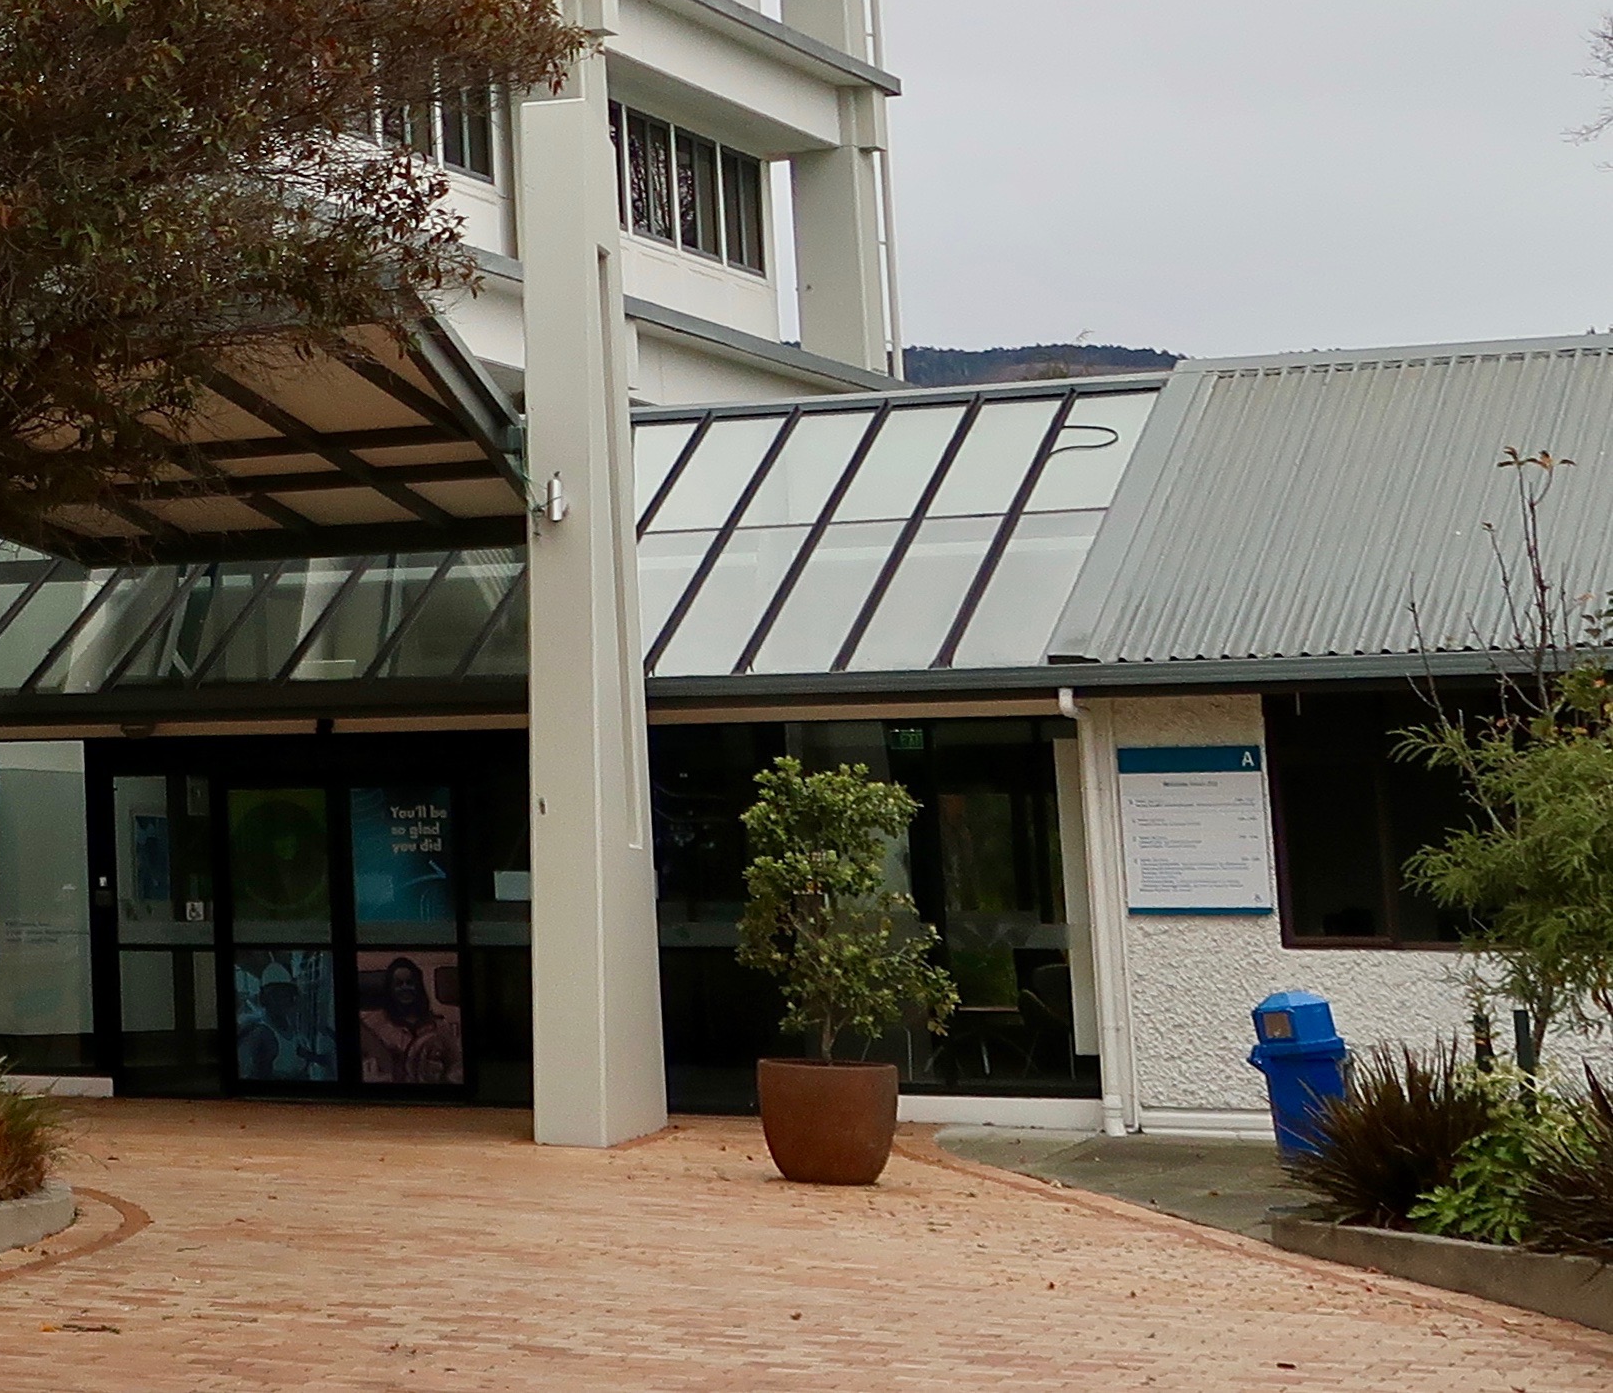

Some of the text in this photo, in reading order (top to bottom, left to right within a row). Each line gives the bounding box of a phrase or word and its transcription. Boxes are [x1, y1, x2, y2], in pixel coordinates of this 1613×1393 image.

[1241, 751, 1255, 767] A
[390, 805, 448, 818] You'll be
[391, 821, 440, 839] so glad
[392, 838, 443, 854] you did
